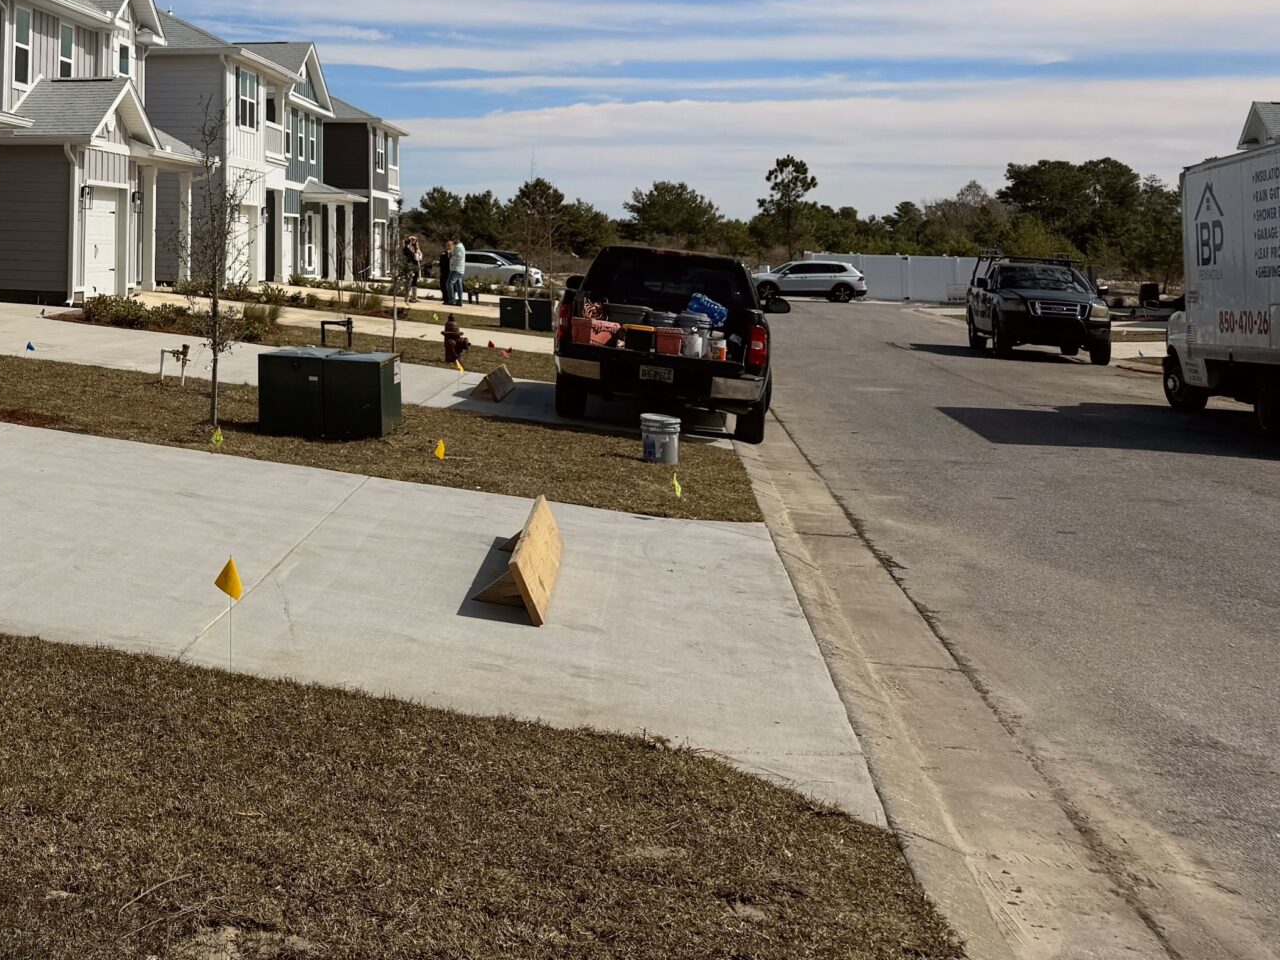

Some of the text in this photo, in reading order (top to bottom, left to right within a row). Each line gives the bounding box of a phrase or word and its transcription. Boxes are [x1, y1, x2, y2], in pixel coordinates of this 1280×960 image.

[1256, 189, 1268, 203] RAIN
[1256, 207, 1277, 221] SHOWER
[1257, 226, 1279, 240] GARAGE
[1195, 220, 1224, 267] IBP
[1257, 246, 1269, 260] LEAF
